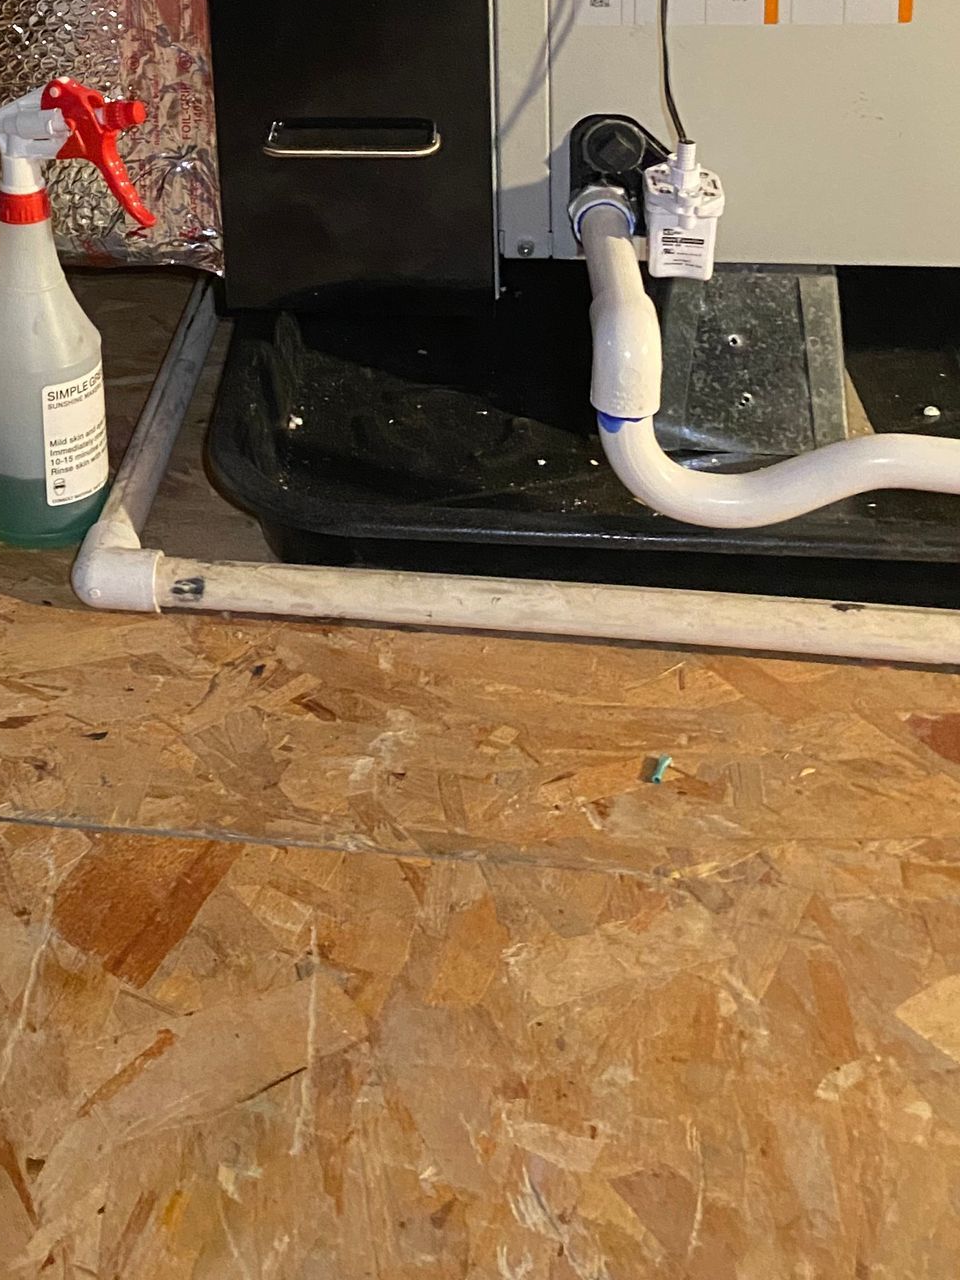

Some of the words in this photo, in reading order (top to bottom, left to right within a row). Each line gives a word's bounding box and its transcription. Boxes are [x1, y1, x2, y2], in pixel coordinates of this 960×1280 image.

[180, 84, 192, 141] FOIL-GRIP
[47, 380, 89, 402] SIMPLE
[49, 438, 68, 448] Mild
[69, 433, 85, 444] skin
[50, 454, 74, 467] 10-15
[50, 466, 74, 476] Rinse
[75, 460, 90, 471] skin
